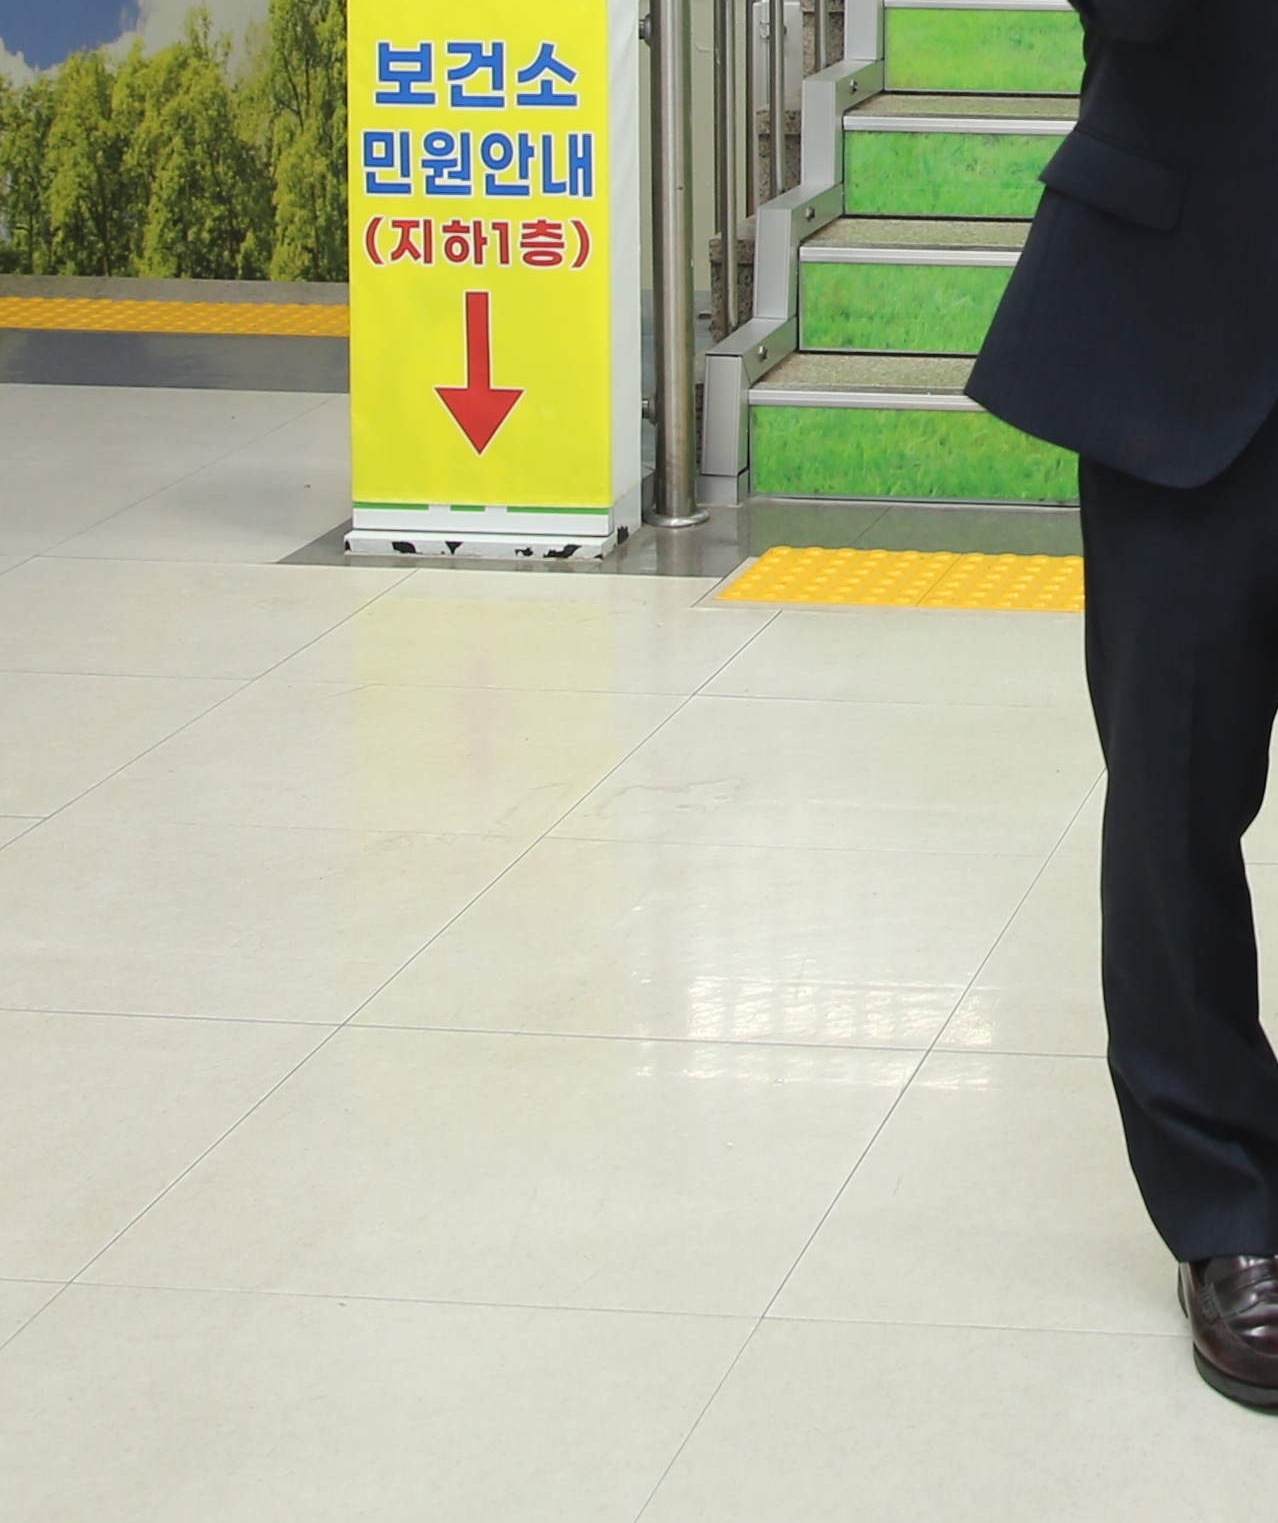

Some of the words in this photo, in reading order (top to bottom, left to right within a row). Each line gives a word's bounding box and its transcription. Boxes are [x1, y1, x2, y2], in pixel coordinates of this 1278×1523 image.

[373, 40, 580, 111] 보건소
[361, 129, 595, 200] 민원안내
[363, 215, 592, 271] (지하1층)
